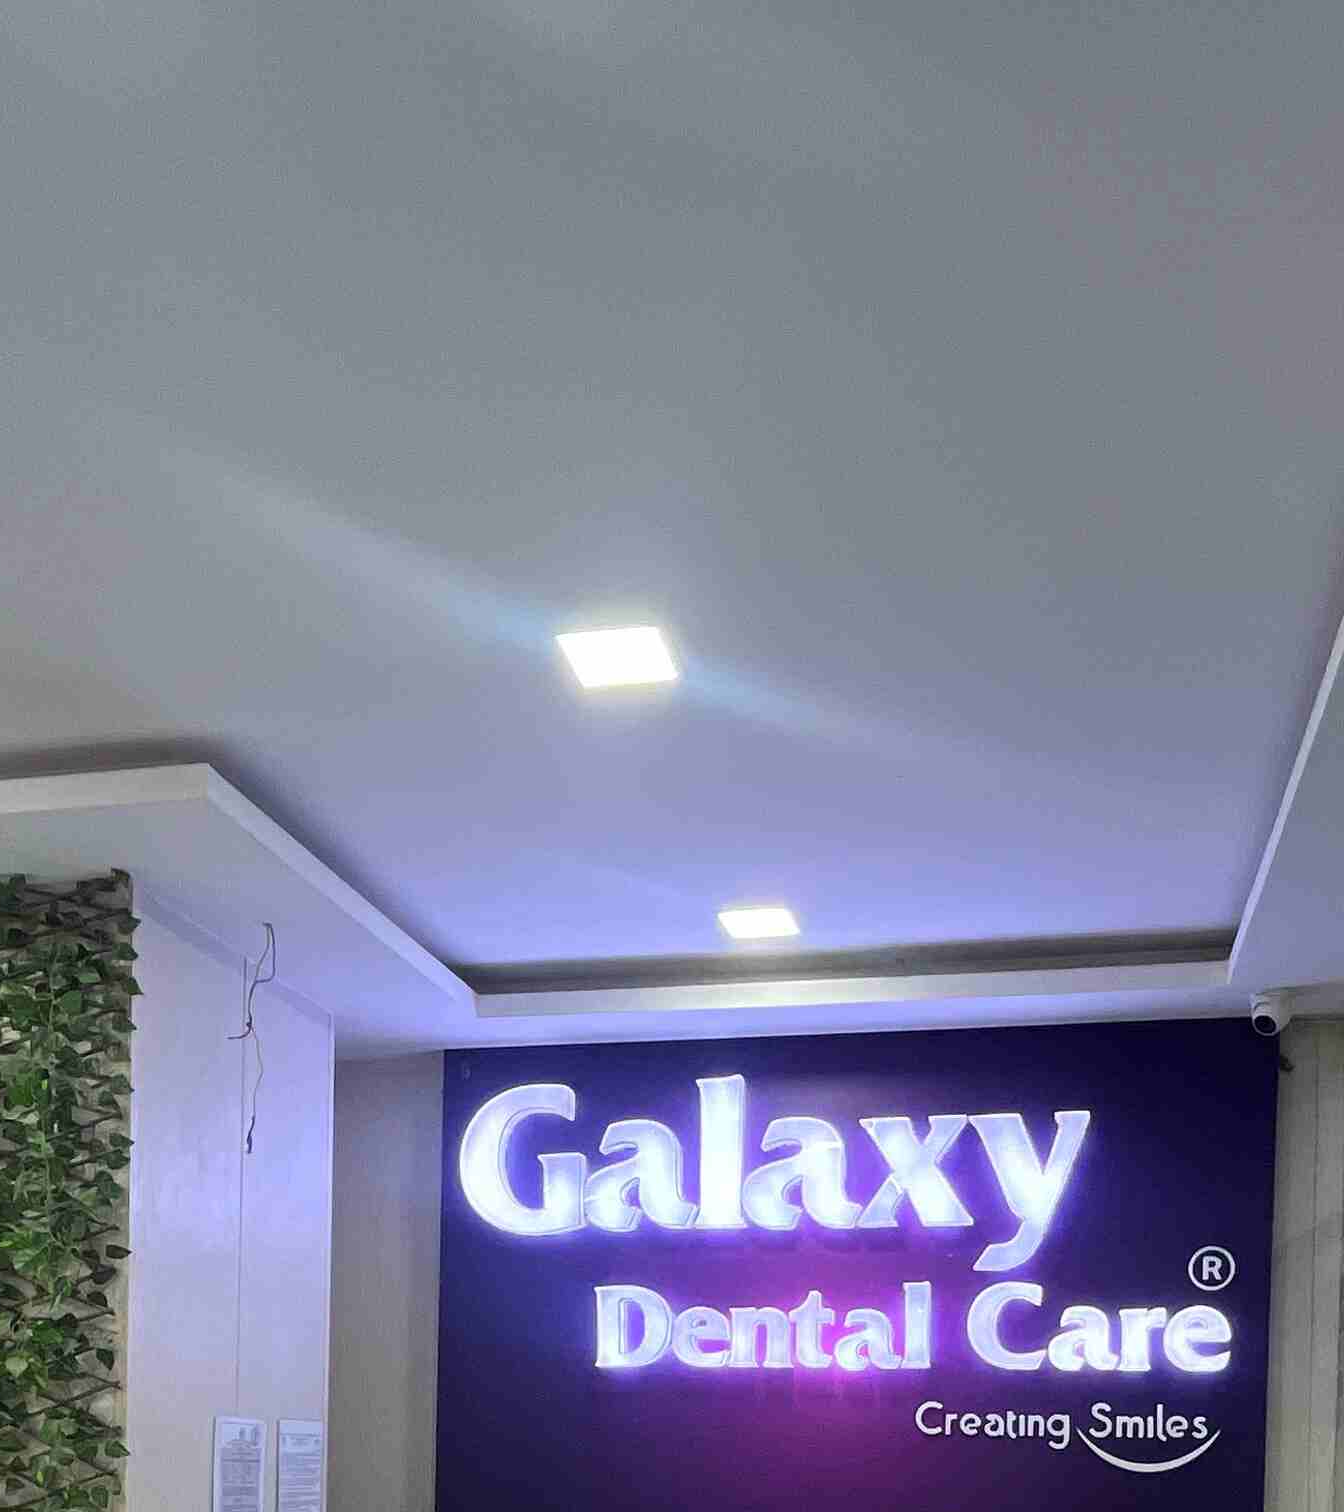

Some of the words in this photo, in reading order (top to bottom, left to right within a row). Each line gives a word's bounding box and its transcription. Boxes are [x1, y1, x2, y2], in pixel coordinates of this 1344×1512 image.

[459, 1073, 1091, 1271] Galaxy
[595, 1281, 932, 1369] Dental
[967, 1281, 1233, 1373] Care
[915, 1402, 1071, 1449] Creating
[1090, 1403, 1210, 1440] Smiles
